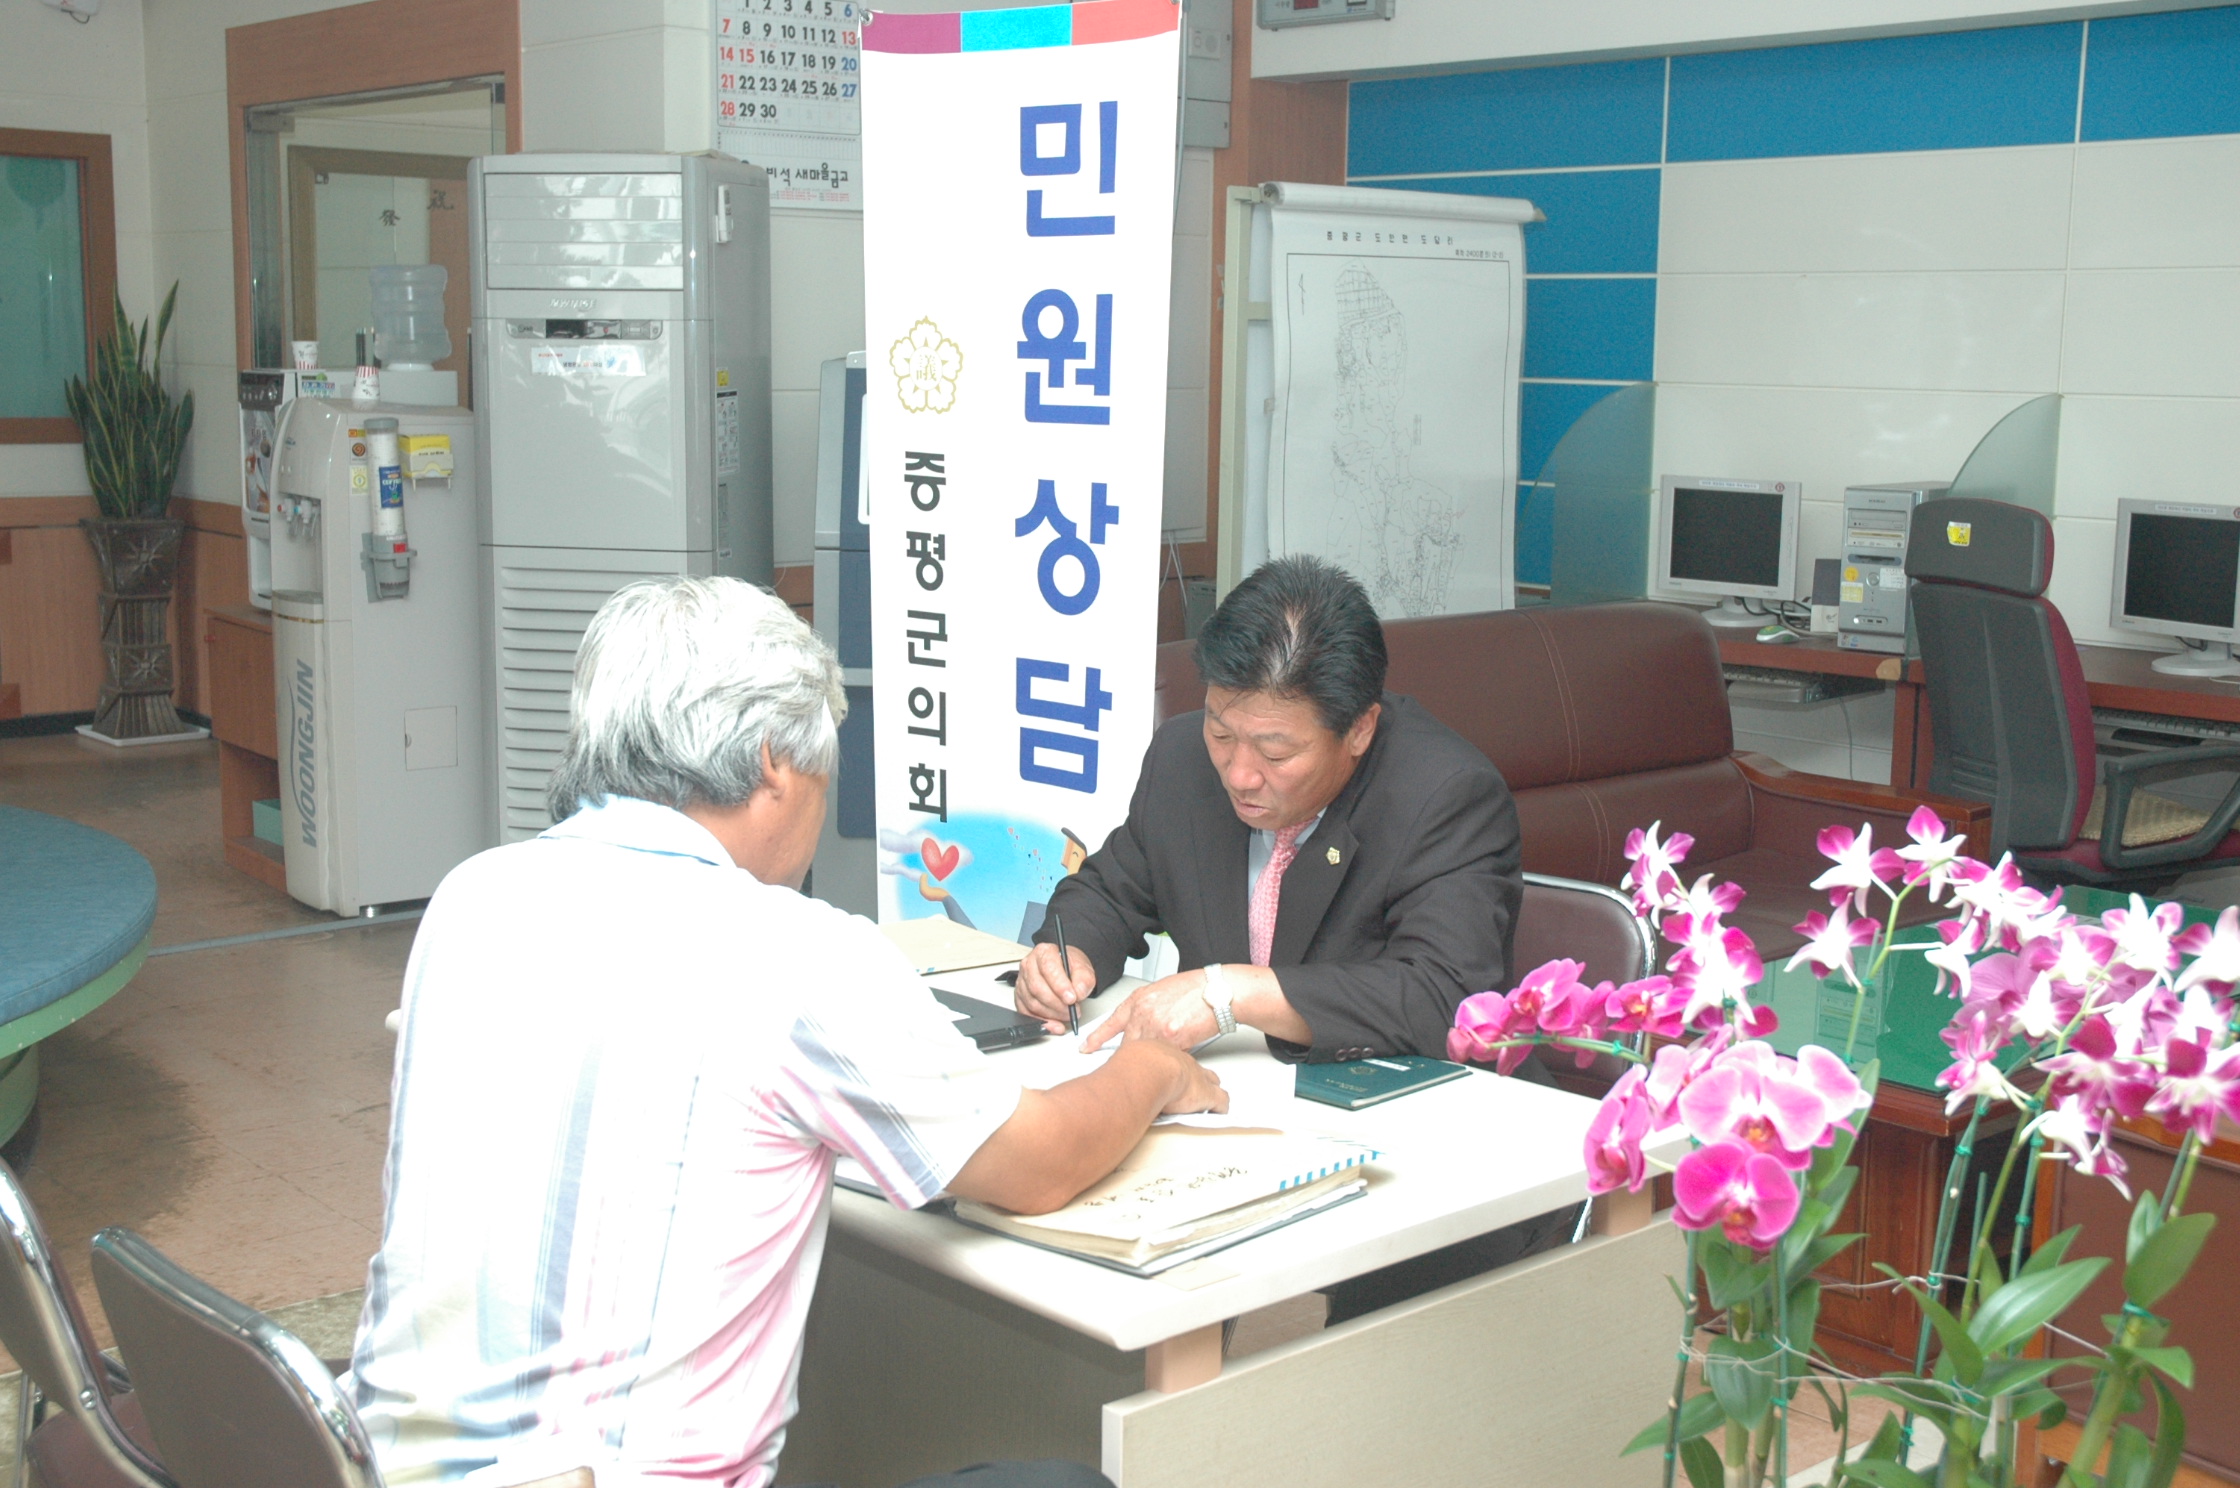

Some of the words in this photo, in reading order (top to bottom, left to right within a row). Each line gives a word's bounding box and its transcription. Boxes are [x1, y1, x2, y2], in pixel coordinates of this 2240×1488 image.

[746, 0, 749, 8] 1
[764, 0, 771, 10] 2
[784, 0, 792, 12] 3
[805, 1, 812, 14] 4
[825, 2, 832, 16] 5
[844, 4, 852, 17] 6
[723, 19, 730, 33] 7
[743, 21, 750, 35] 8
[763, 23, 771, 37] 9
[782, 25, 795, 39] 10
[803, 27, 815, 41] 11
[822, 30, 835, 43] 12
[842, 32, 856, 45] 13
[720, 47, 733, 61] 14
[740, 49, 754, 63] 15
[761, 51, 775, 64] 16
[781, 52, 795, 66] 17
[802, 55, 815, 68] 18
[822, 56, 836, 69] 19
[842, 57, 857, 70] 20
[721, 74, 734, 88] 21
[739, 76, 755, 89] 22
[760, 77, 777, 91] 23
[782, 79, 797, 93] 24
[802, 81, 817, 94] 25
[822, 82, 837, 96] 26
[842, 84, 857, 97] 27
[721, 101, 734, 116] 28
[739, 103, 755, 117] 29
[761, 104, 776, 118] 30
[795, 162, 848, 188] 새마을금고
[1016, 101, 1119, 793] 민원상담
[905, 451, 948, 823] 증평군의회
[297, 658, 316, 846] WOONGJIN
